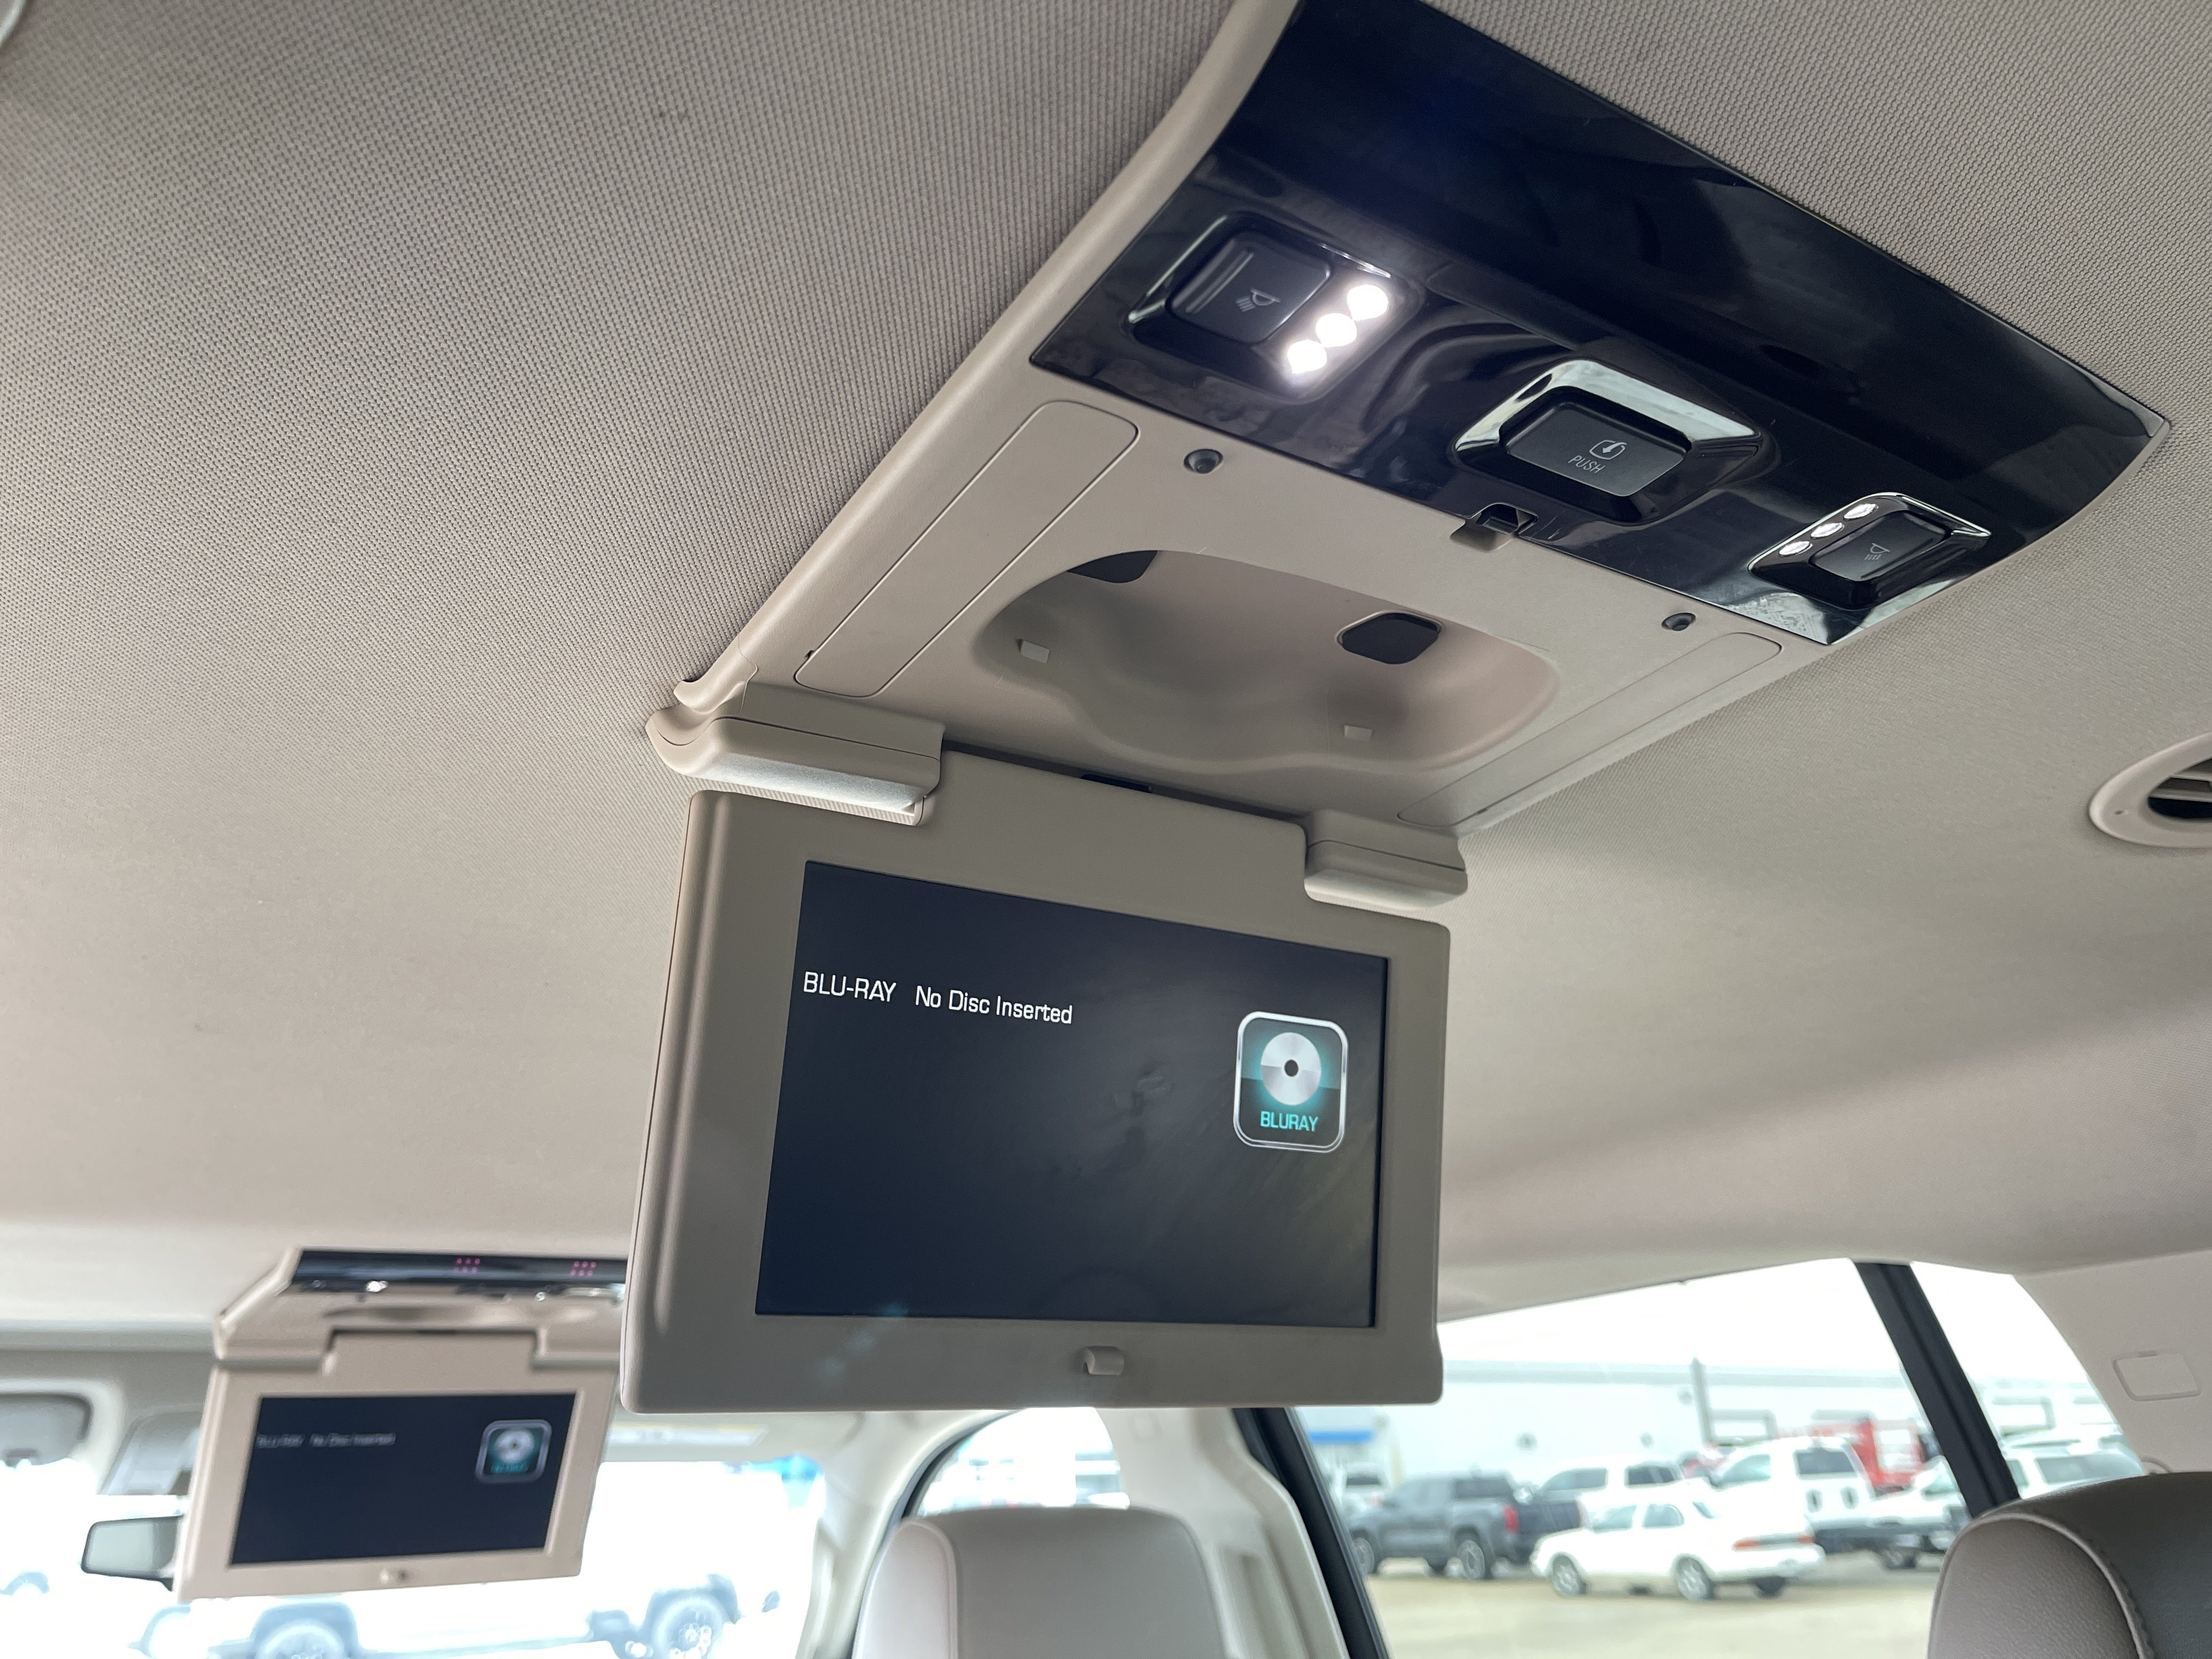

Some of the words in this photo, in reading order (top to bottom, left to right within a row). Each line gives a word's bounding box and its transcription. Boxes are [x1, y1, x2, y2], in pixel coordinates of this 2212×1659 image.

[1567, 455, 1606, 474] PUSH
[803, 971, 897, 1002] BLU-RAY
[915, 985, 941, 1008] No
[949, 989, 990, 1014] Disc
[996, 995, 1073, 1024] Inserted
[1260, 1110, 1319, 1132] BLURAY
